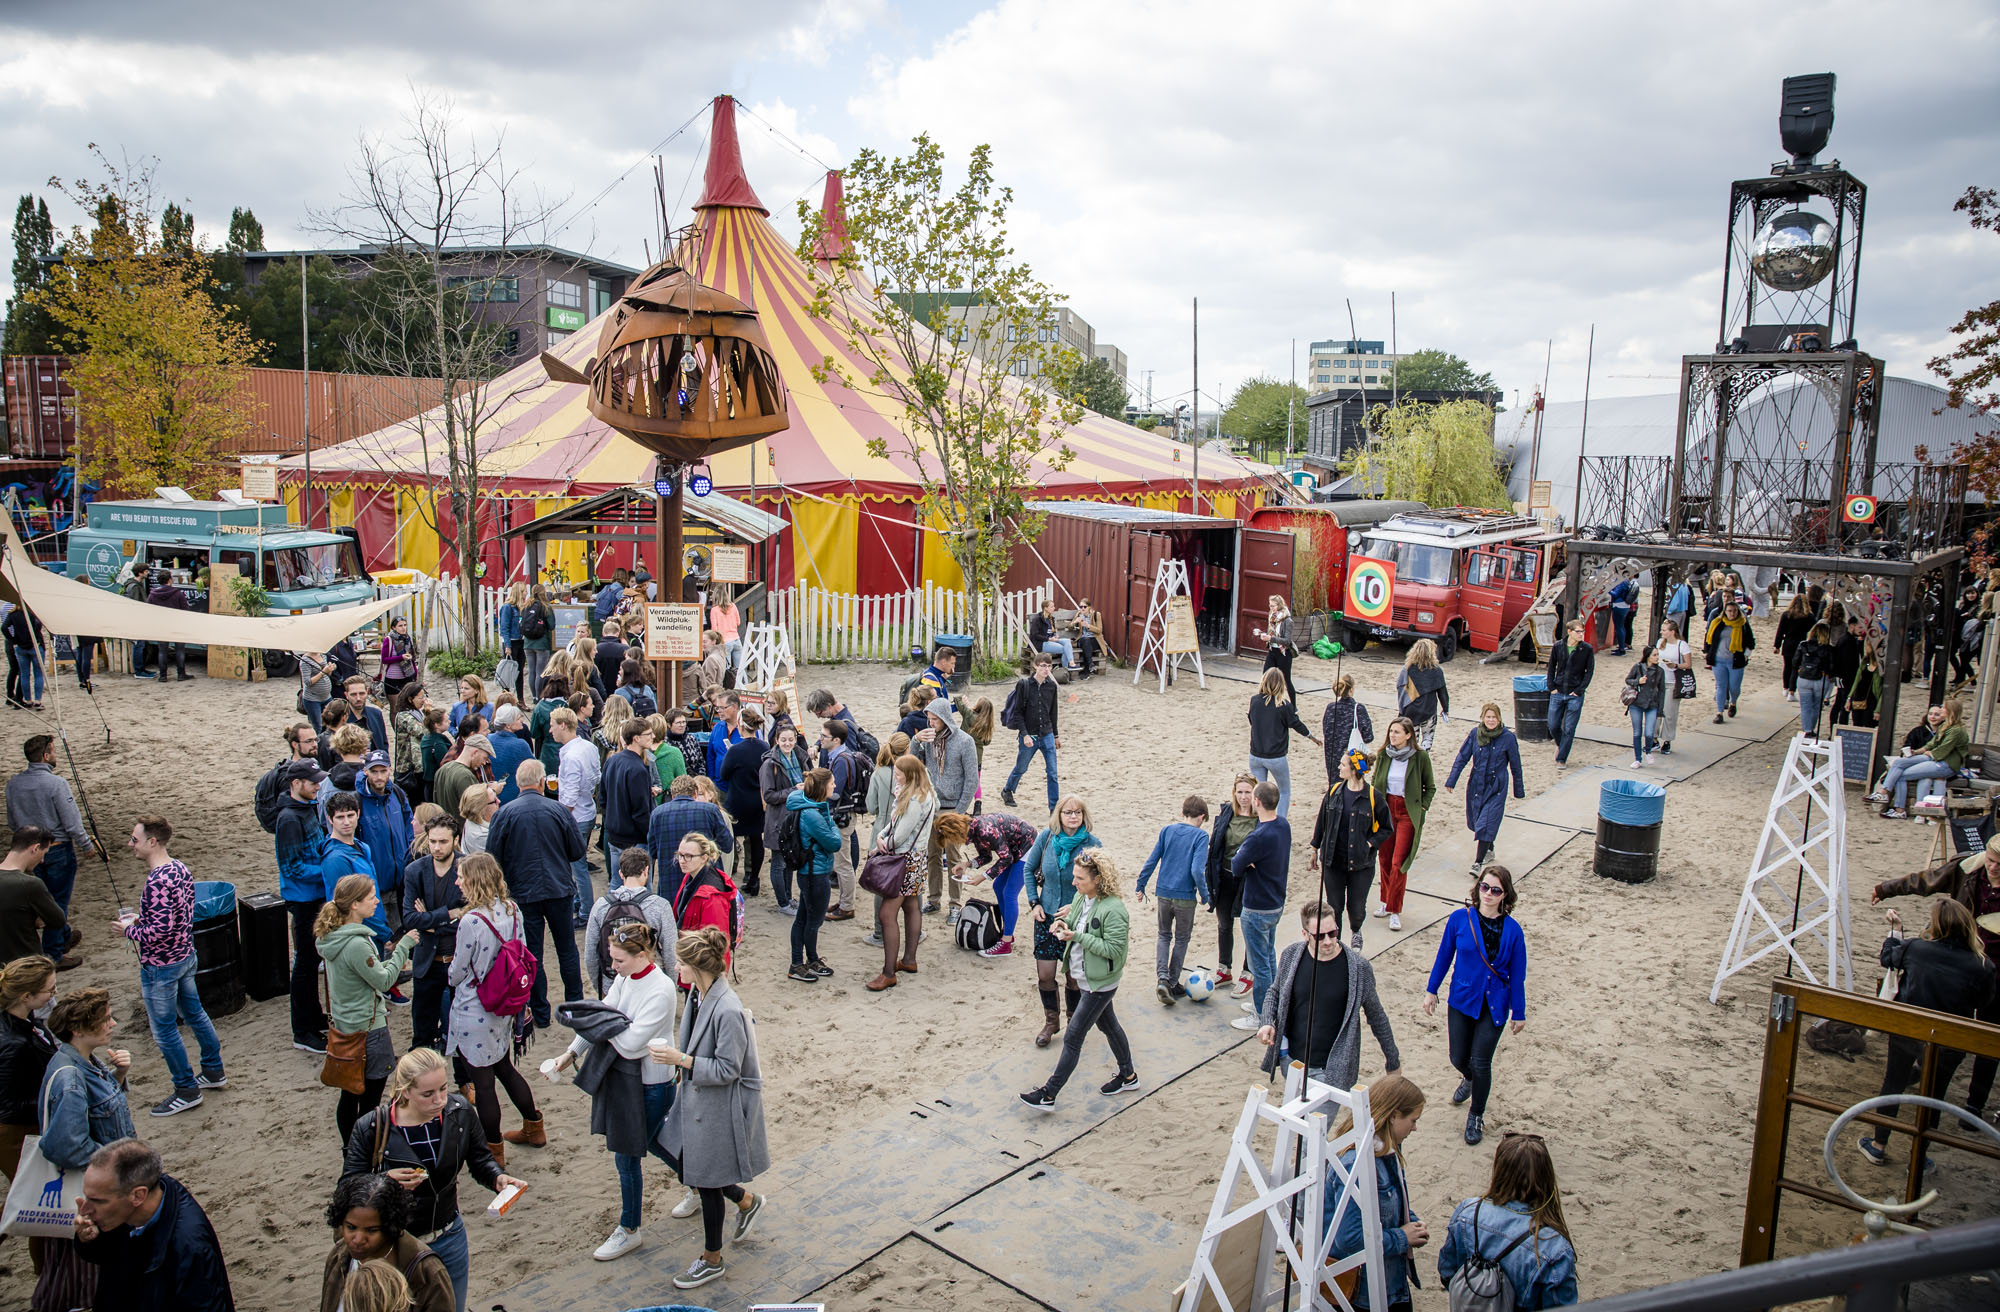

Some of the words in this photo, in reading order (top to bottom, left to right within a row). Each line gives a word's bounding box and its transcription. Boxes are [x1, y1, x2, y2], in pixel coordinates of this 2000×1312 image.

[1855, 502, 1866, 516] 9
[110, 513, 121, 521] ARE
[134, 515, 151, 523] READY
[160, 517, 181, 525] RESCUE
[182, 518, 197, 526] FOOD
[1356, 576, 1384, 604] 10
